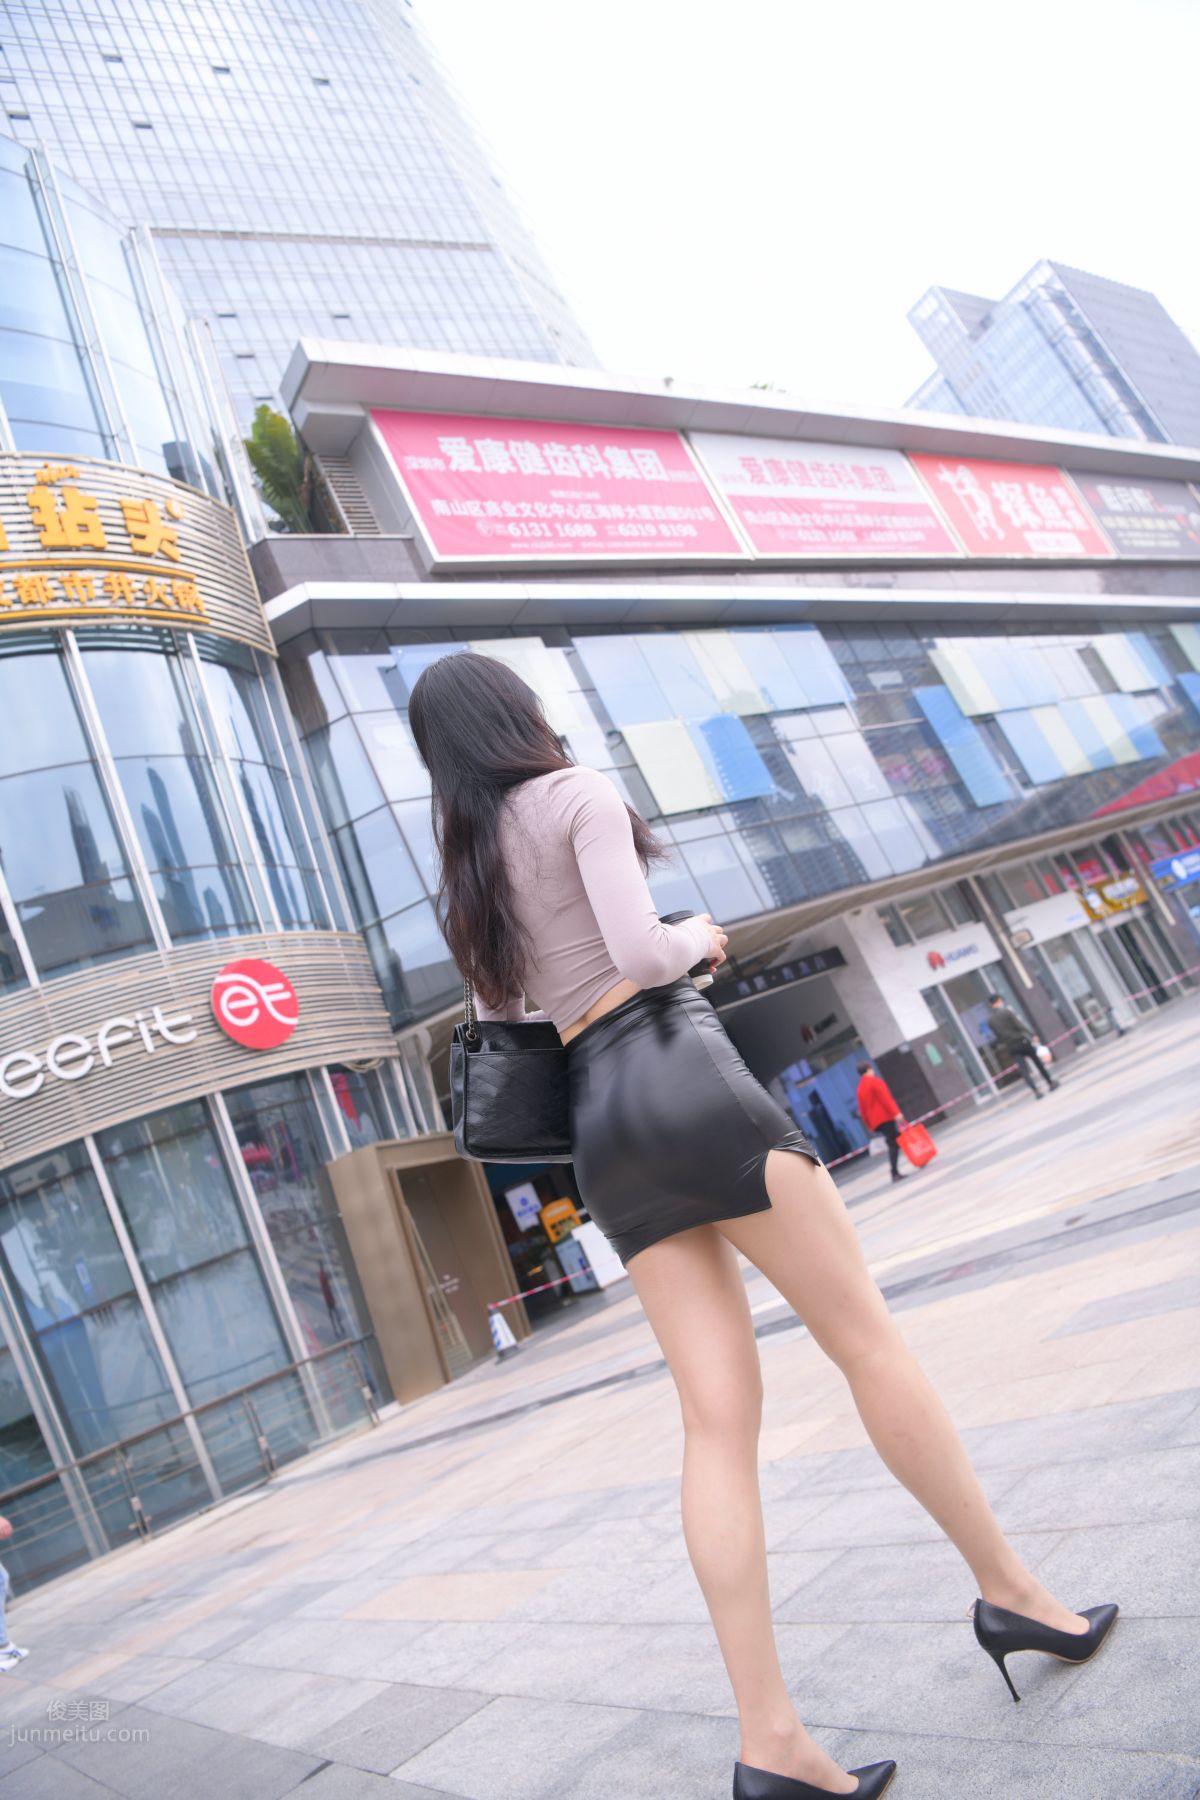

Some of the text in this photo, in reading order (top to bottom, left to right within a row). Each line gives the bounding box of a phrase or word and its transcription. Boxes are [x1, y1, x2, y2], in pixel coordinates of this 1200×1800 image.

[437, 436, 669, 481] 爱康健齿科集团
